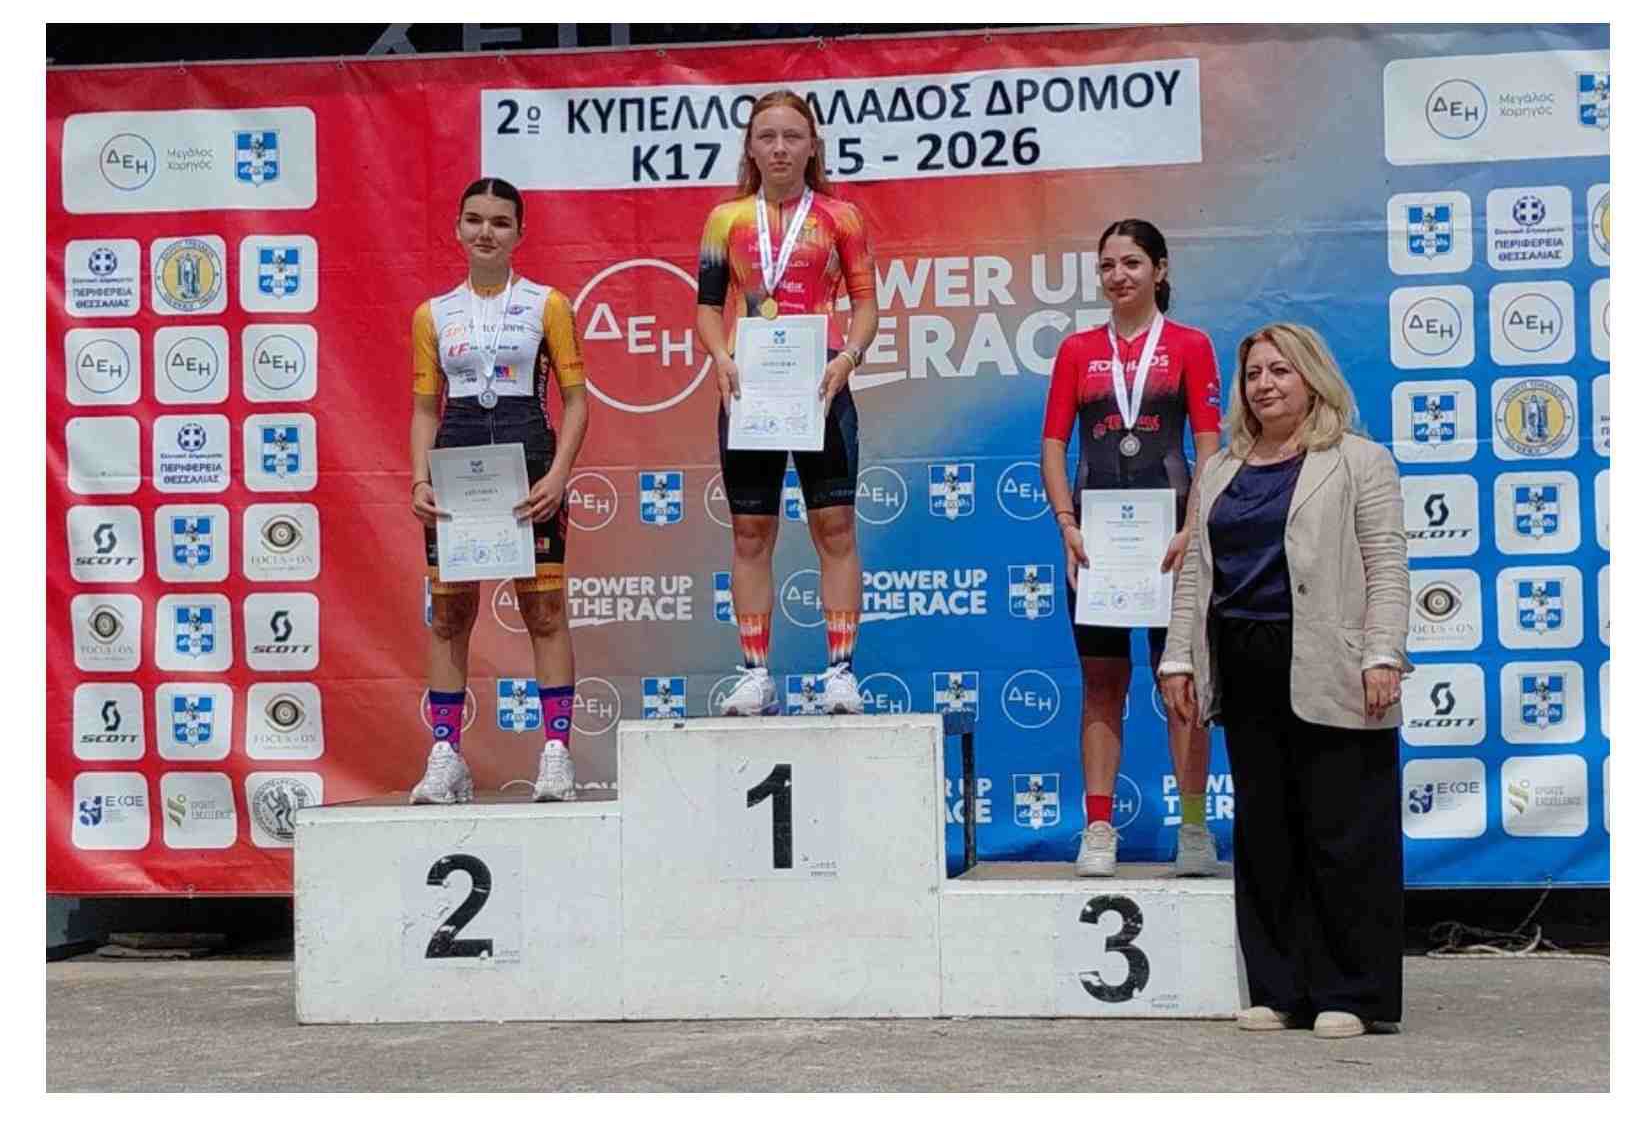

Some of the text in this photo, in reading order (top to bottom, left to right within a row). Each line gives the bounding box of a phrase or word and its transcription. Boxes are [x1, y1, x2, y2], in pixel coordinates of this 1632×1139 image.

[807, 82, 971, 125] ΛΛΑΔΟΣ
[985, 70, 1181, 116] ΔΡΟΜΟΥ
[633, 127, 1041, 182] Κ17 2026
[585, 303, 694, 367] ΔΕΗ
[1406, 529, 1472, 539] SCOTT
[75, 557, 138, 566] SCOTT
[568, 576, 693, 596] POWER UP
[954, 569, 987, 588] UP
[568, 597, 692, 621] THE RACE
[863, 591, 987, 615] THE RACE
[252, 644, 311, 654] SCOTT
[1408, 718, 1478, 728] SCOTT
[80, 734, 138, 743] SCOTT
[746, 763, 794, 869] 1
[425, 854, 493, 959] 2
[1079, 895, 1150, 1003] 3
